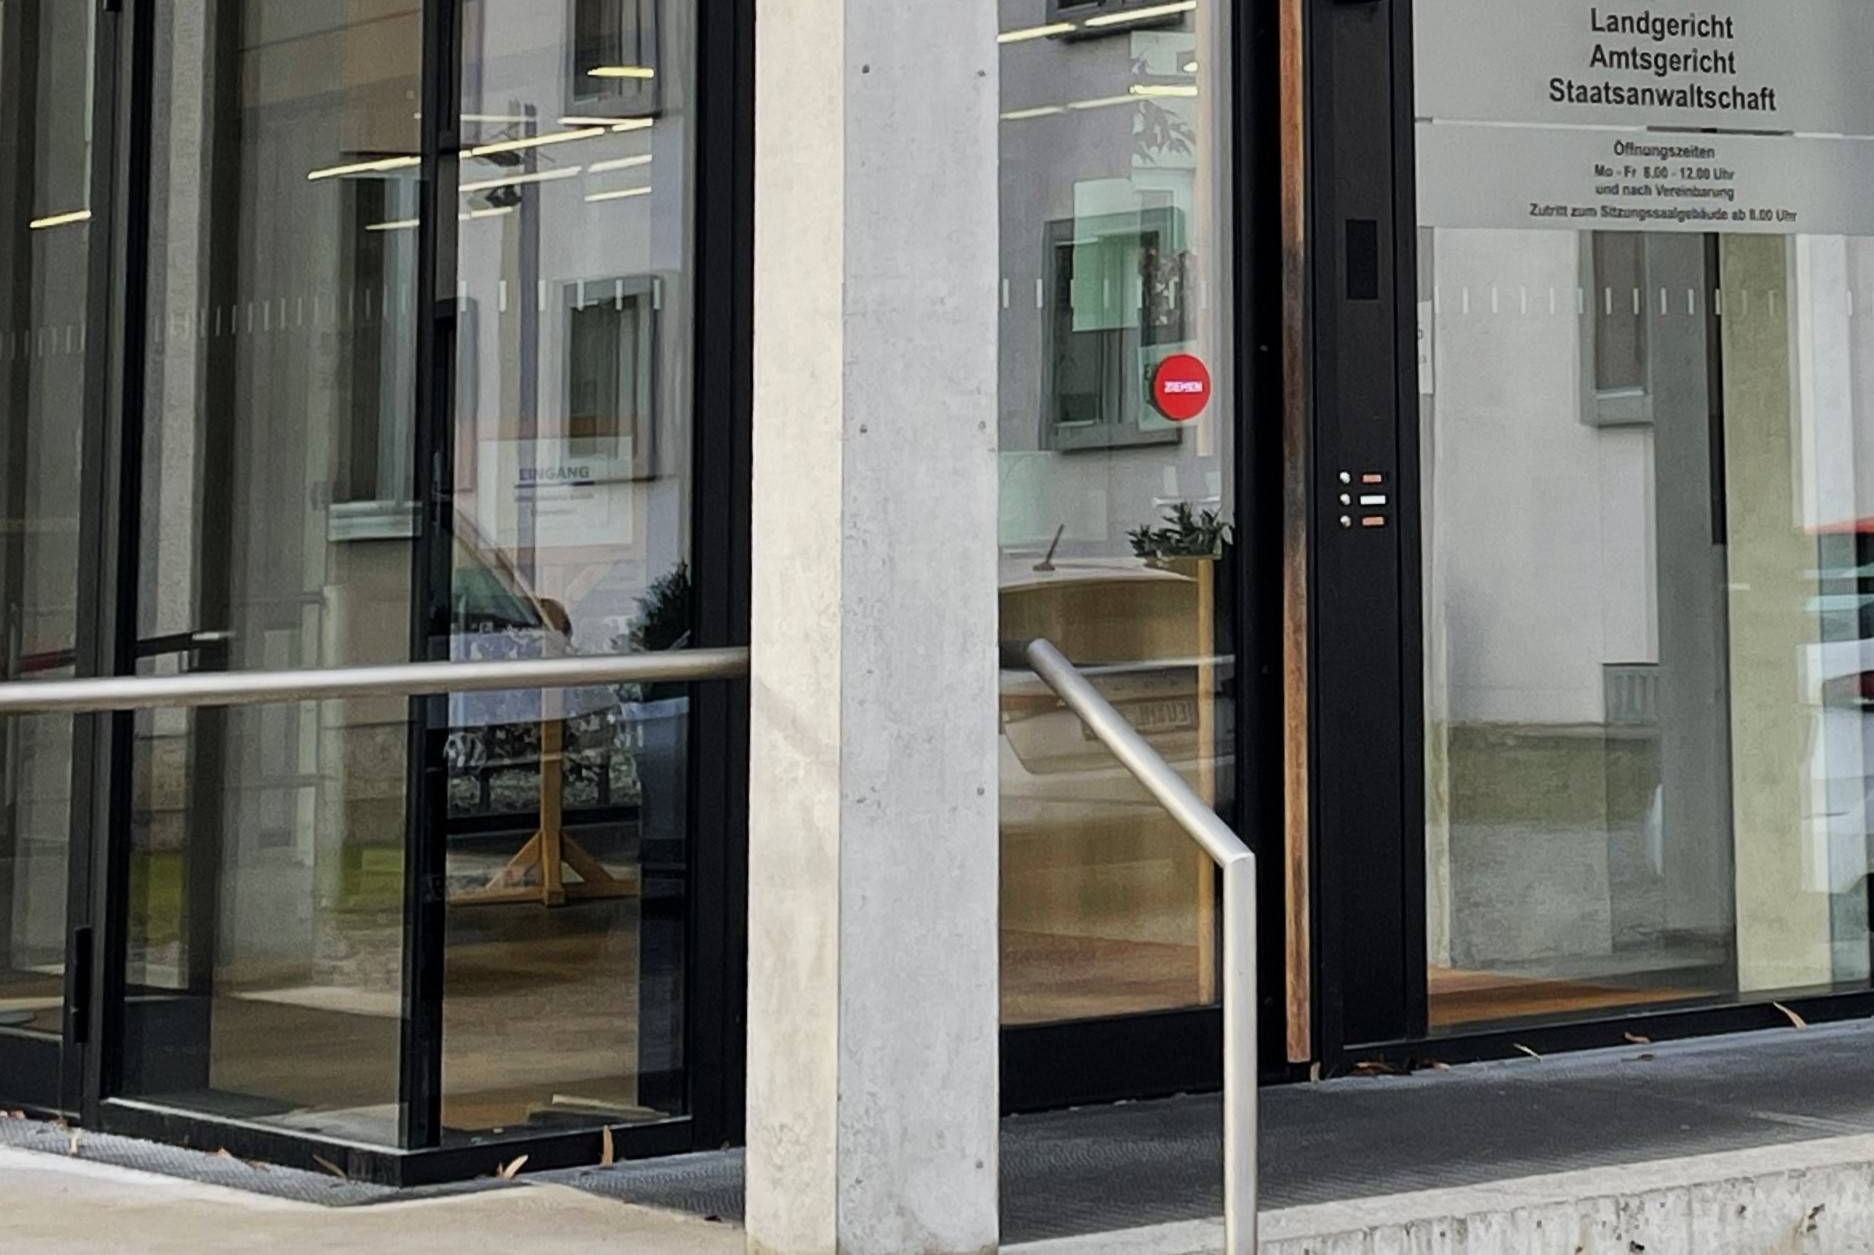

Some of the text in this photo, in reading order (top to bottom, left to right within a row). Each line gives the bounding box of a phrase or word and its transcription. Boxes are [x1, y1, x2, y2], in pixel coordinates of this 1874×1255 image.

[1590, 7, 1734, 41] Landgericht
[1589, 44, 1737, 77] Amtsgericht
[1548, 78, 1777, 112] Staatsanwaltschaft
[1594, 164, 1614, 178] Mo
[1623, 165, 1637, 178] Fr
[1680, 167, 1711, 180] 12.00
[1713, 168, 1735, 181] Uhr
[1595, 184, 1735, 202] und nach Vereinbarung
[1529, 203, 1568, 217] Zutritt
[1571, 207, 1598, 218] zum
[1731, 208, 1746, 222] ab
[1776, 209, 1798, 223] Uhr
